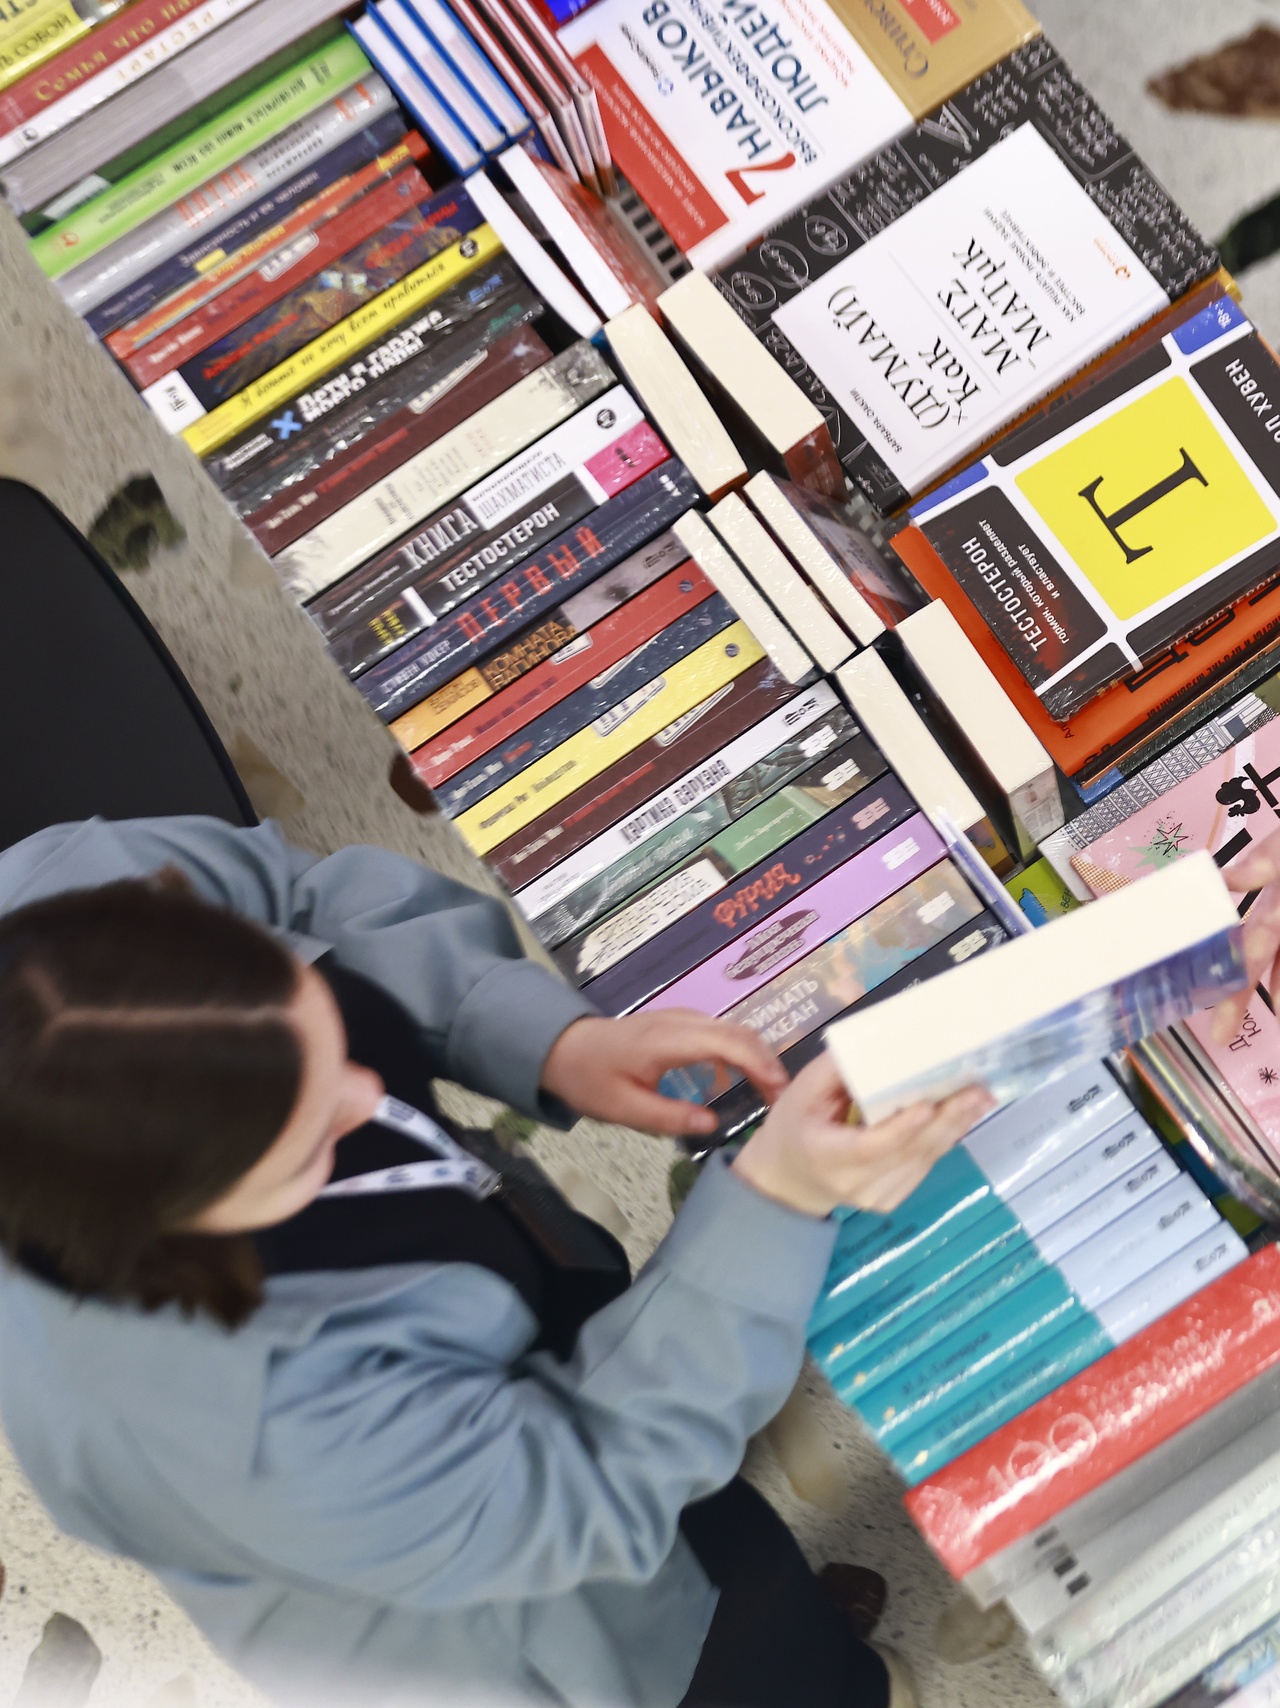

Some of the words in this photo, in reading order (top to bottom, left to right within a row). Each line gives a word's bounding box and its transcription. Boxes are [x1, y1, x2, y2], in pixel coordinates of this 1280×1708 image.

[11, 9, 72, 60] СОБОЙ
[31, 46, 109, 104] Семья
[110, 14, 157, 53] что
[637, 0, 773, 161] НАВЫКОВ
[727, 151, 797, 207] 7
[821, 282, 952, 432] (ДУМАЙ)
[1223, 357, 1273, 416] ХУВЕН
[870, 415, 903, 454] БАРБАРА
[399, 502, 478, 573] КНИГА
[476, 449, 567, 520] ШАХМАТИСТА
[438, 500, 561, 596] ТЕСТОСТЕРОН
[977, 517, 1017, 567] разделяет
[1017, 542, 1055, 591] властвует
[454, 523, 606, 645] ПЕРВЫЙ
[960, 535, 1049, 651] ТЕСТОСТЕРОН
[1009, 564, 1046, 608] который
[1049, 589, 1060, 599] и
[481, 616, 564, 679] КОМНАТА
[1038, 605, 1070, 645] гормон,
[662, 875, 714, 917] ДОМА
[710, 856, 803, 933] ФУРИЯ
[742, 972, 819, 1032] ОЙМАТЬ
[762, 997, 819, 1043] КЕАН
